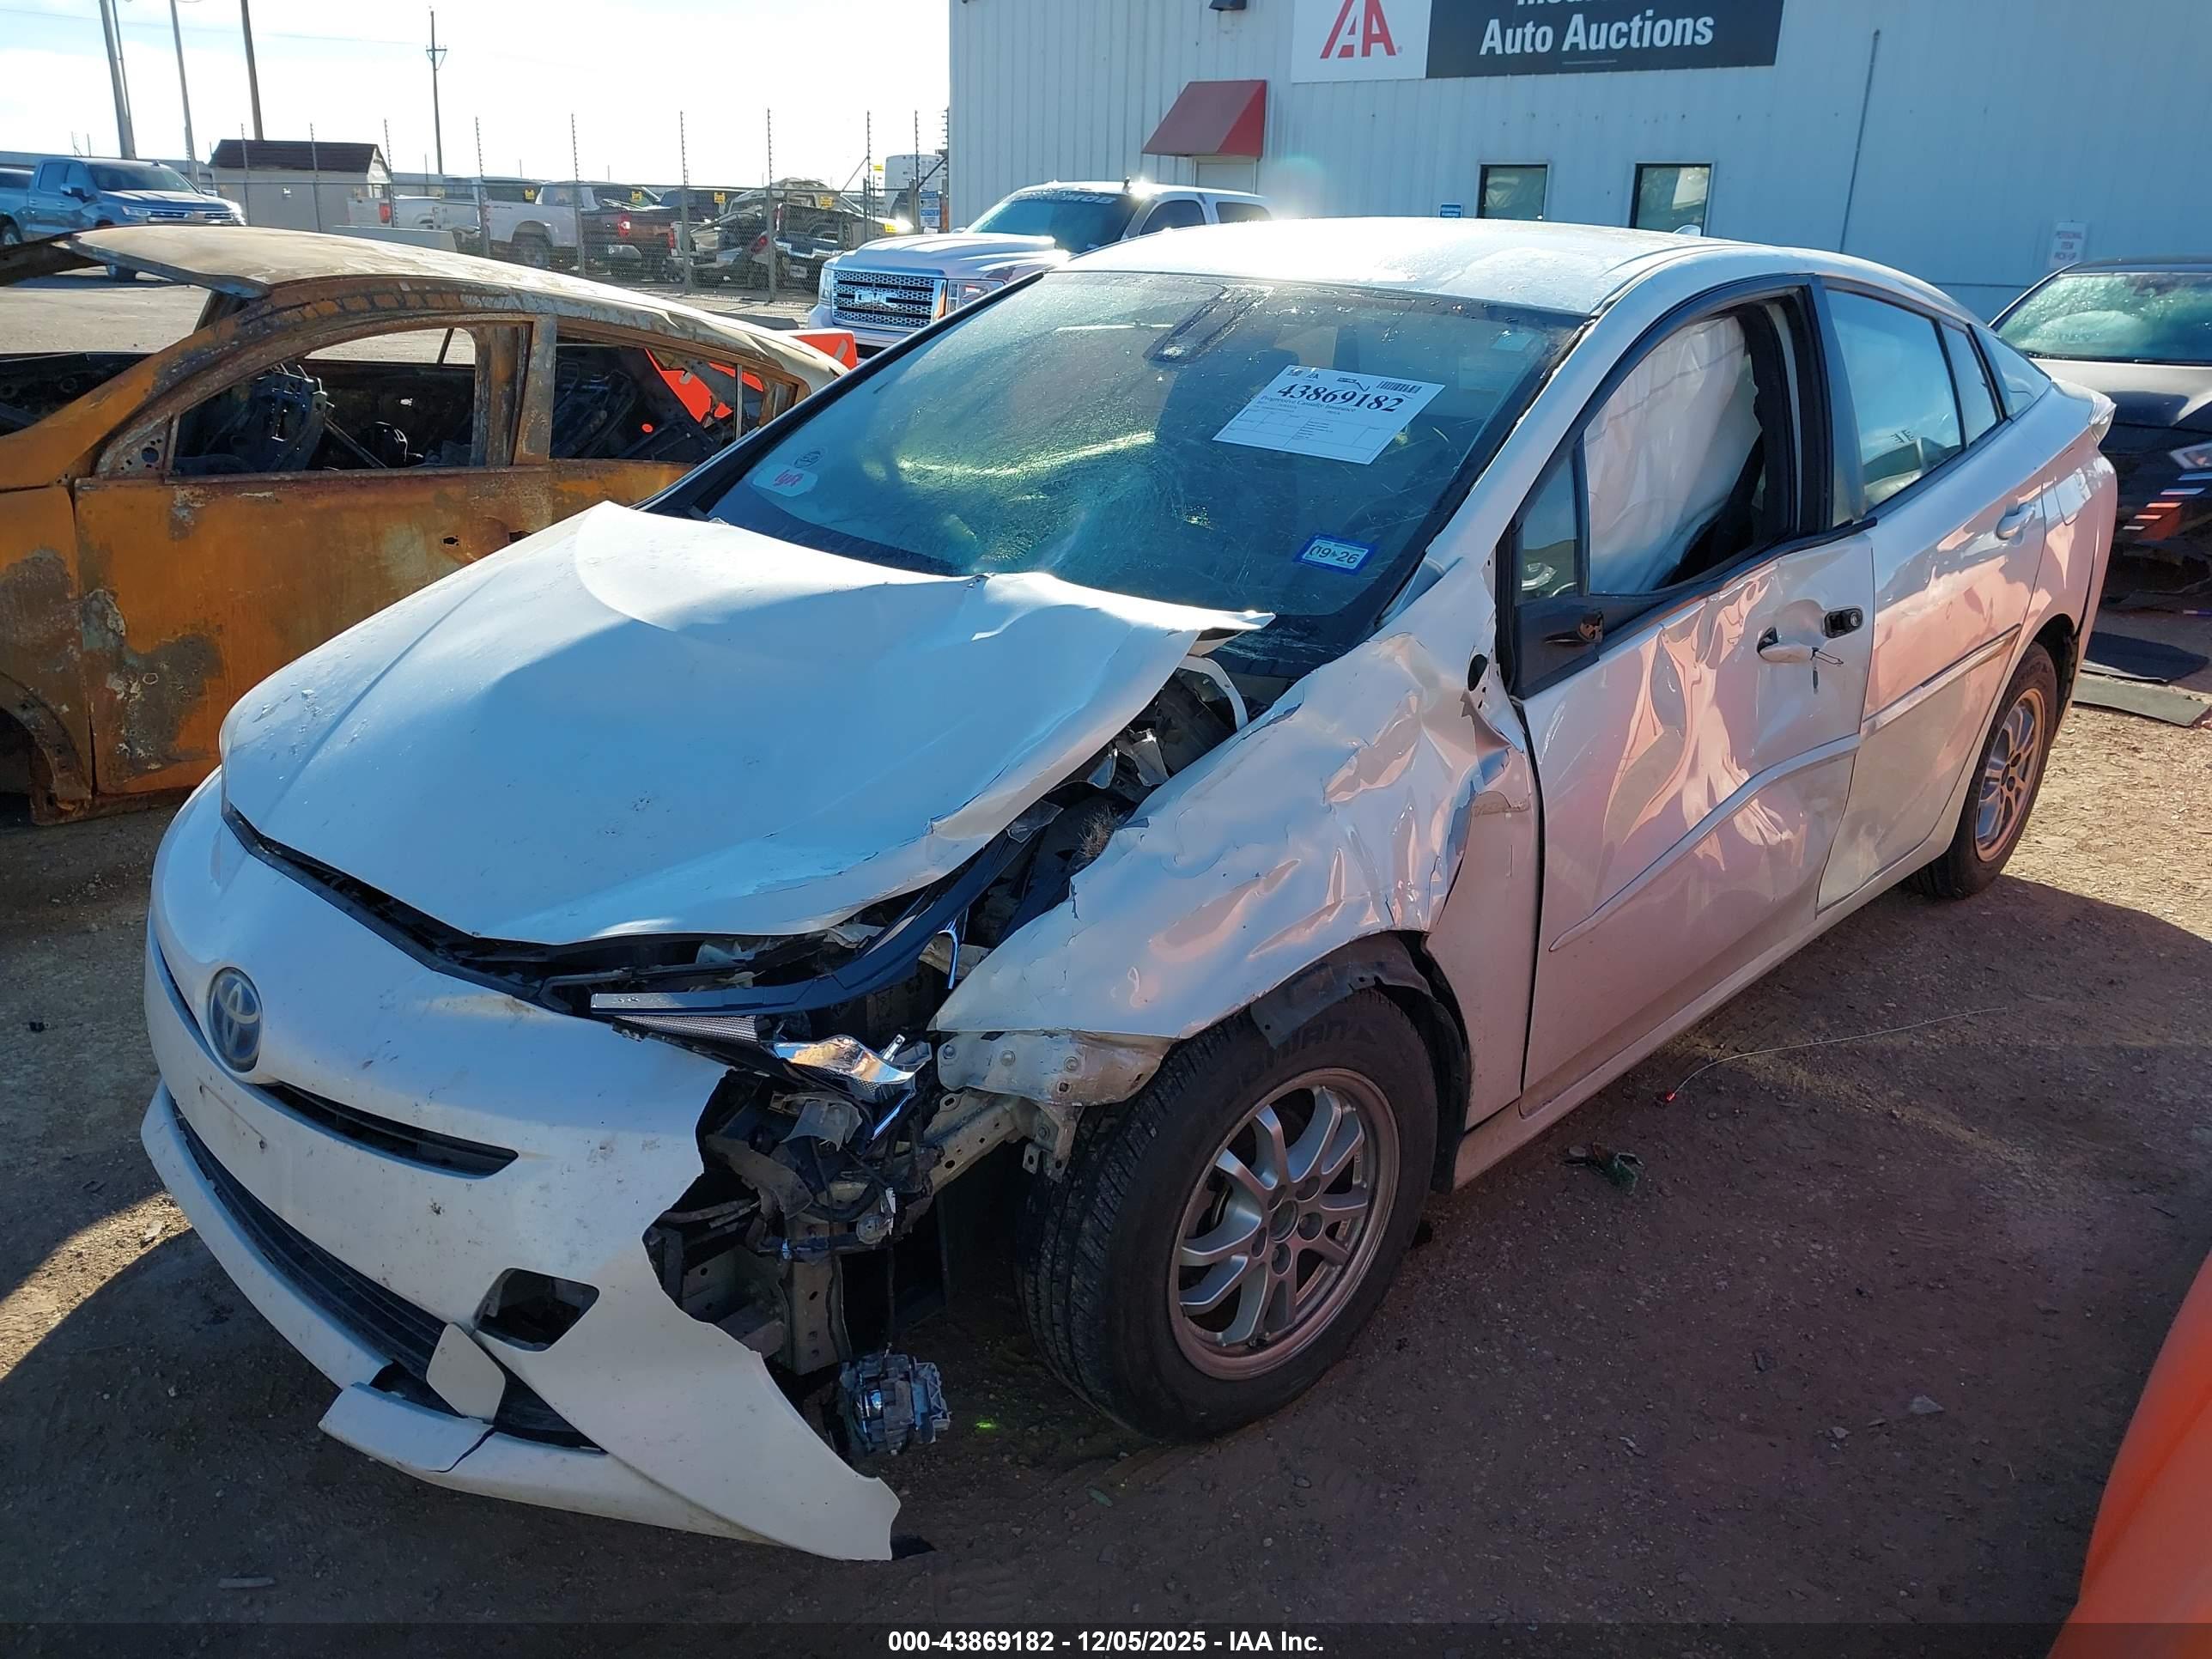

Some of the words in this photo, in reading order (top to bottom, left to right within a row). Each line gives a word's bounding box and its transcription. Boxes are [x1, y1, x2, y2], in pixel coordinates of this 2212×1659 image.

[1479, 18, 1554, 56] Auto
[1561, 9, 1716, 52] Auctions
[1277, 383, 1405, 413] 43869182
[1335, 550, 1360, 564] 26
